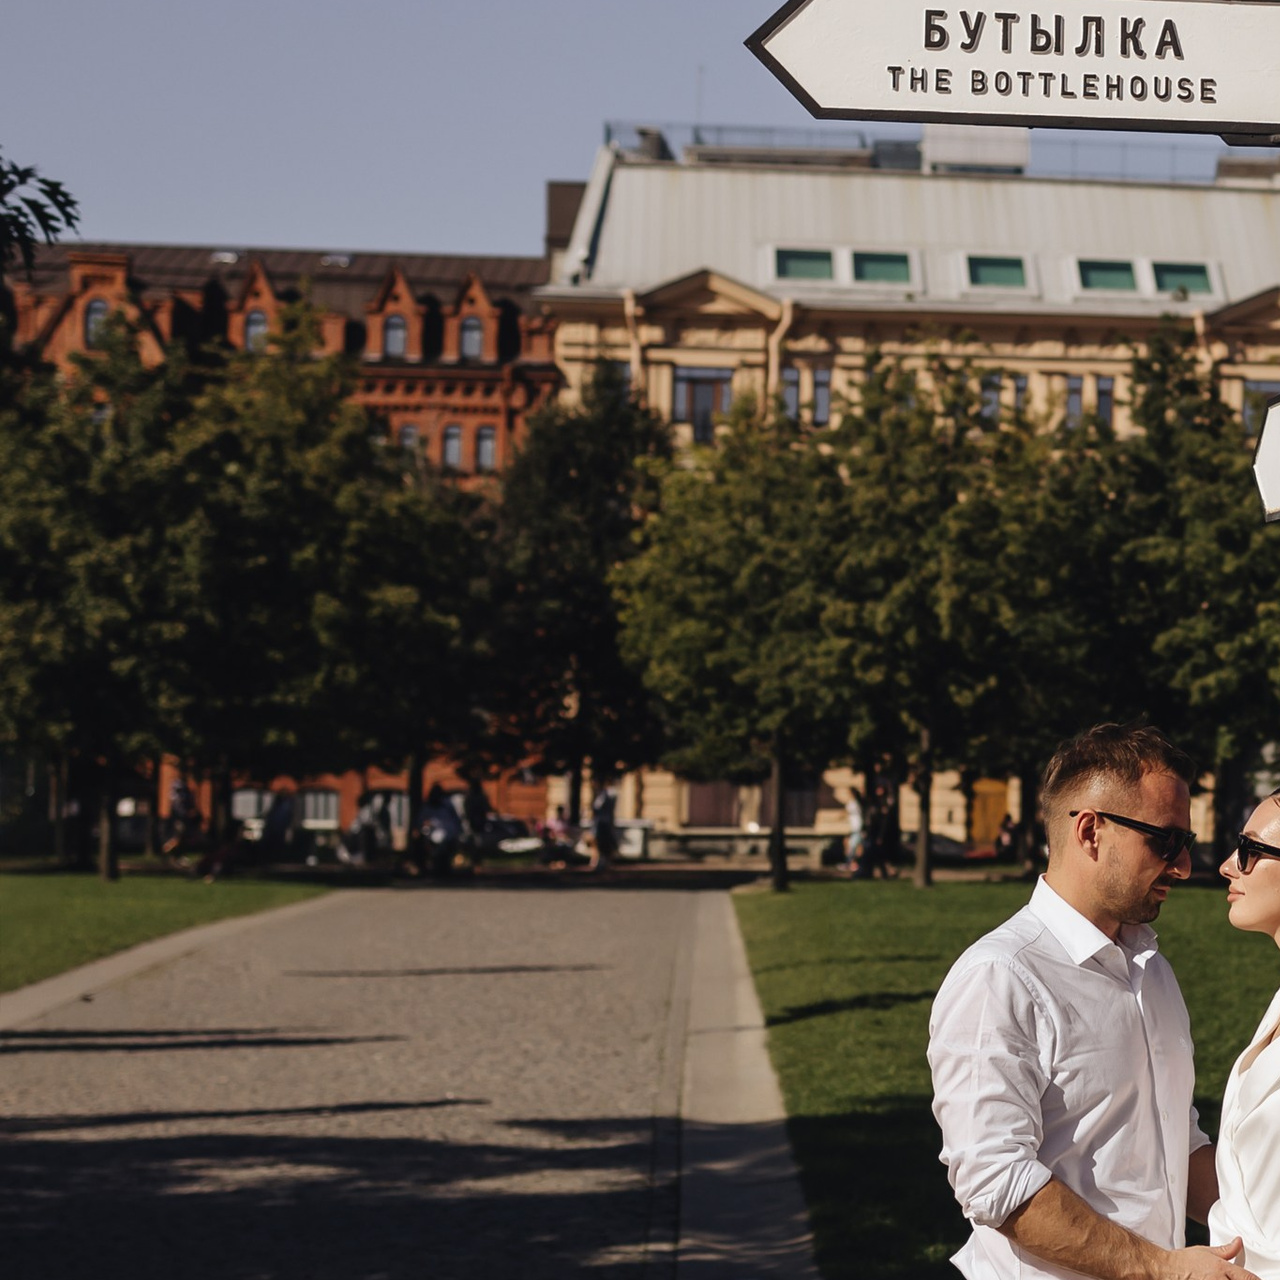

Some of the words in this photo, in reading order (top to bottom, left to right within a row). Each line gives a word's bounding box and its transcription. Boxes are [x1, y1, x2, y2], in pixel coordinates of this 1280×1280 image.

[924, 9, 1184, 60] БУТЫЛКА
[887, 65, 952, 94] THE
[970, 69, 1217, 104] BOTTLEHOUSE
